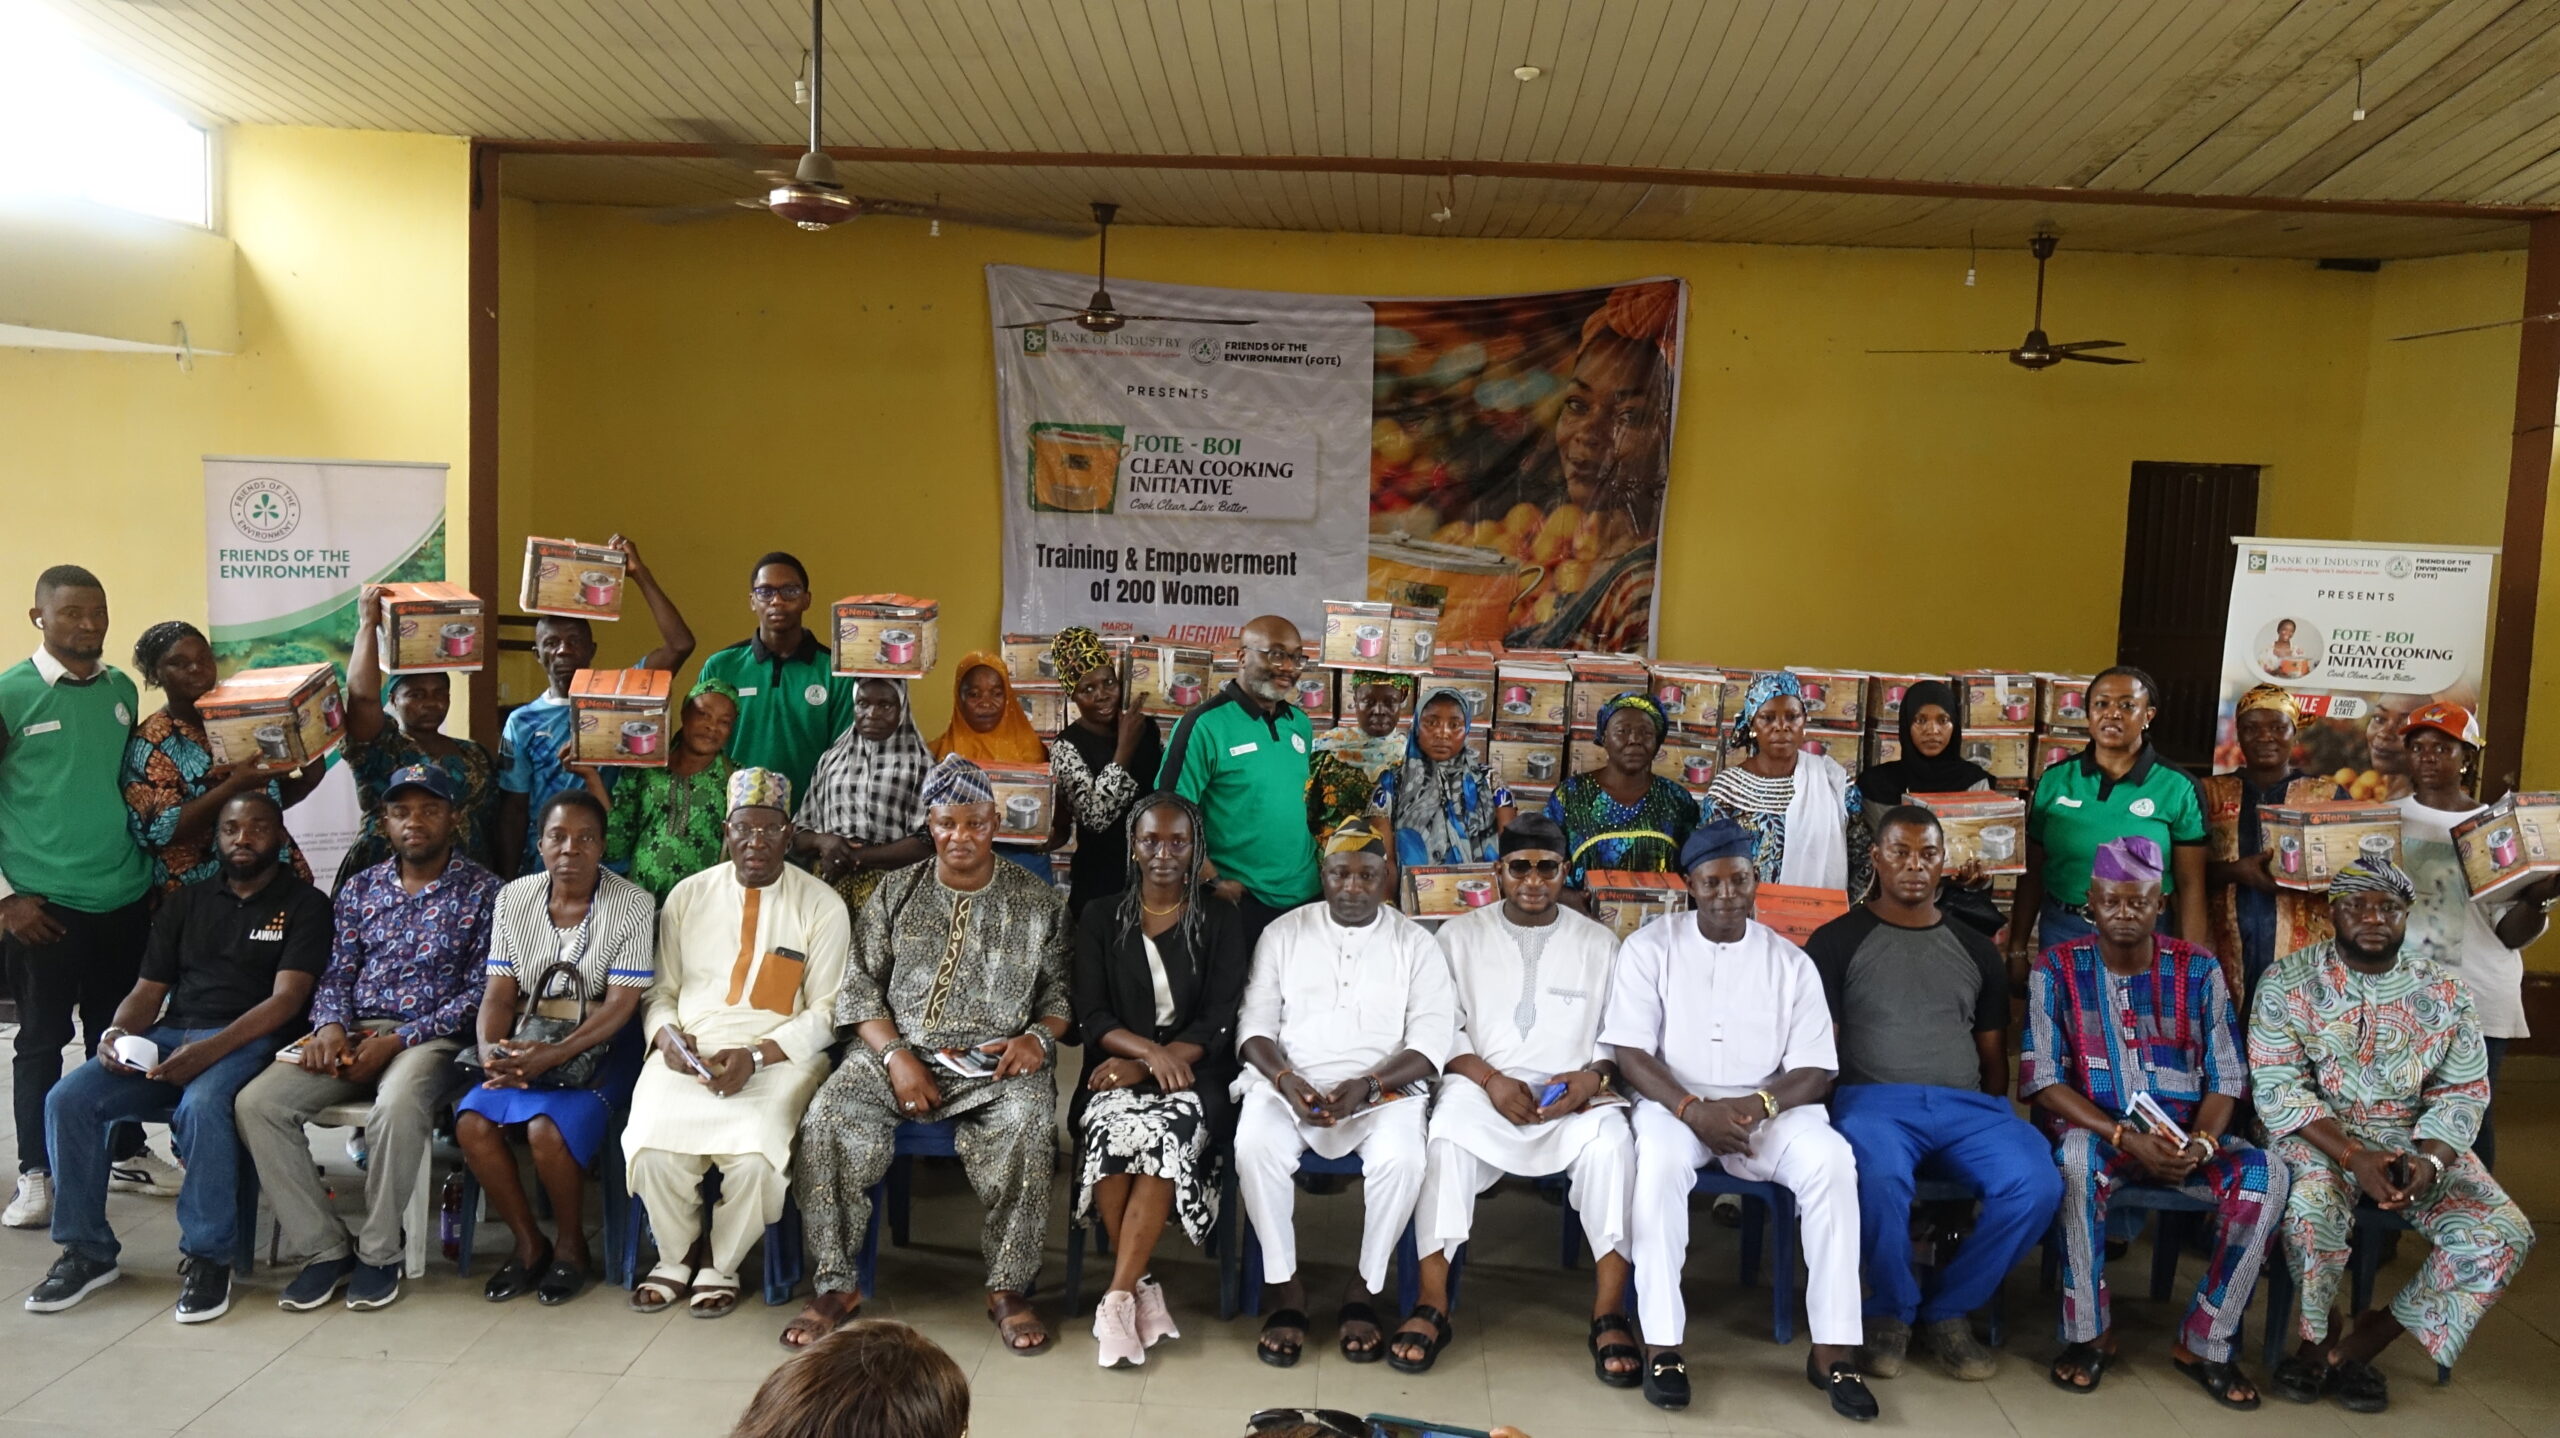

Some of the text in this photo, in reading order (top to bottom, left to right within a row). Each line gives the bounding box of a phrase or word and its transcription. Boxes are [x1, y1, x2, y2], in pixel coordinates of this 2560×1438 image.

[1225, 341, 1307, 352] FRIENDS OF THE
[1224, 353, 1342, 368] ENVIRONMENT (FOTE)
[1126, 385, 1210, 399] PRESENTS
[1133, 434, 1185, 453] FOTE
[1202, 436, 1242, 455] BOI
[1130, 457, 1294, 479] CLEAN COOKING
[1129, 476, 1233, 496] INITIATIVE
[234, 481, 296, 508] FRIENDS OF THE
[1129, 498, 1154, 511] Cook
[1189, 499, 1215, 512] Live
[237, 519, 293, 540] ENVIRONMENT
[219, 549, 350, 562] FRIENDS OF THE
[1036, 543, 1297, 576] Training & Empowerment
[220, 565, 350, 579] ENVIRONMENT
[2413, 572, 2438, 580] (FOTE)
[2415, 565, 2468, 573] ENVIRONMENT
[1090, 579, 1239, 606] of 200 Women
[2318, 589, 2395, 602] PRESENTS
[1101, 621, 1133, 632] MARCH
[2332, 628, 2372, 642] FOTE
[2385, 631, 2414, 644] BOI
[2328, 643, 2453, 661] CLEAN COOKING
[2327, 655, 2406, 671] INITIATIVE
[2326, 670, 2346, 678] Cook
[2334, 699, 2357, 708] LAGOS
[2333, 708, 2354, 716] STATE
[249, 928, 284, 942] LAWMA
